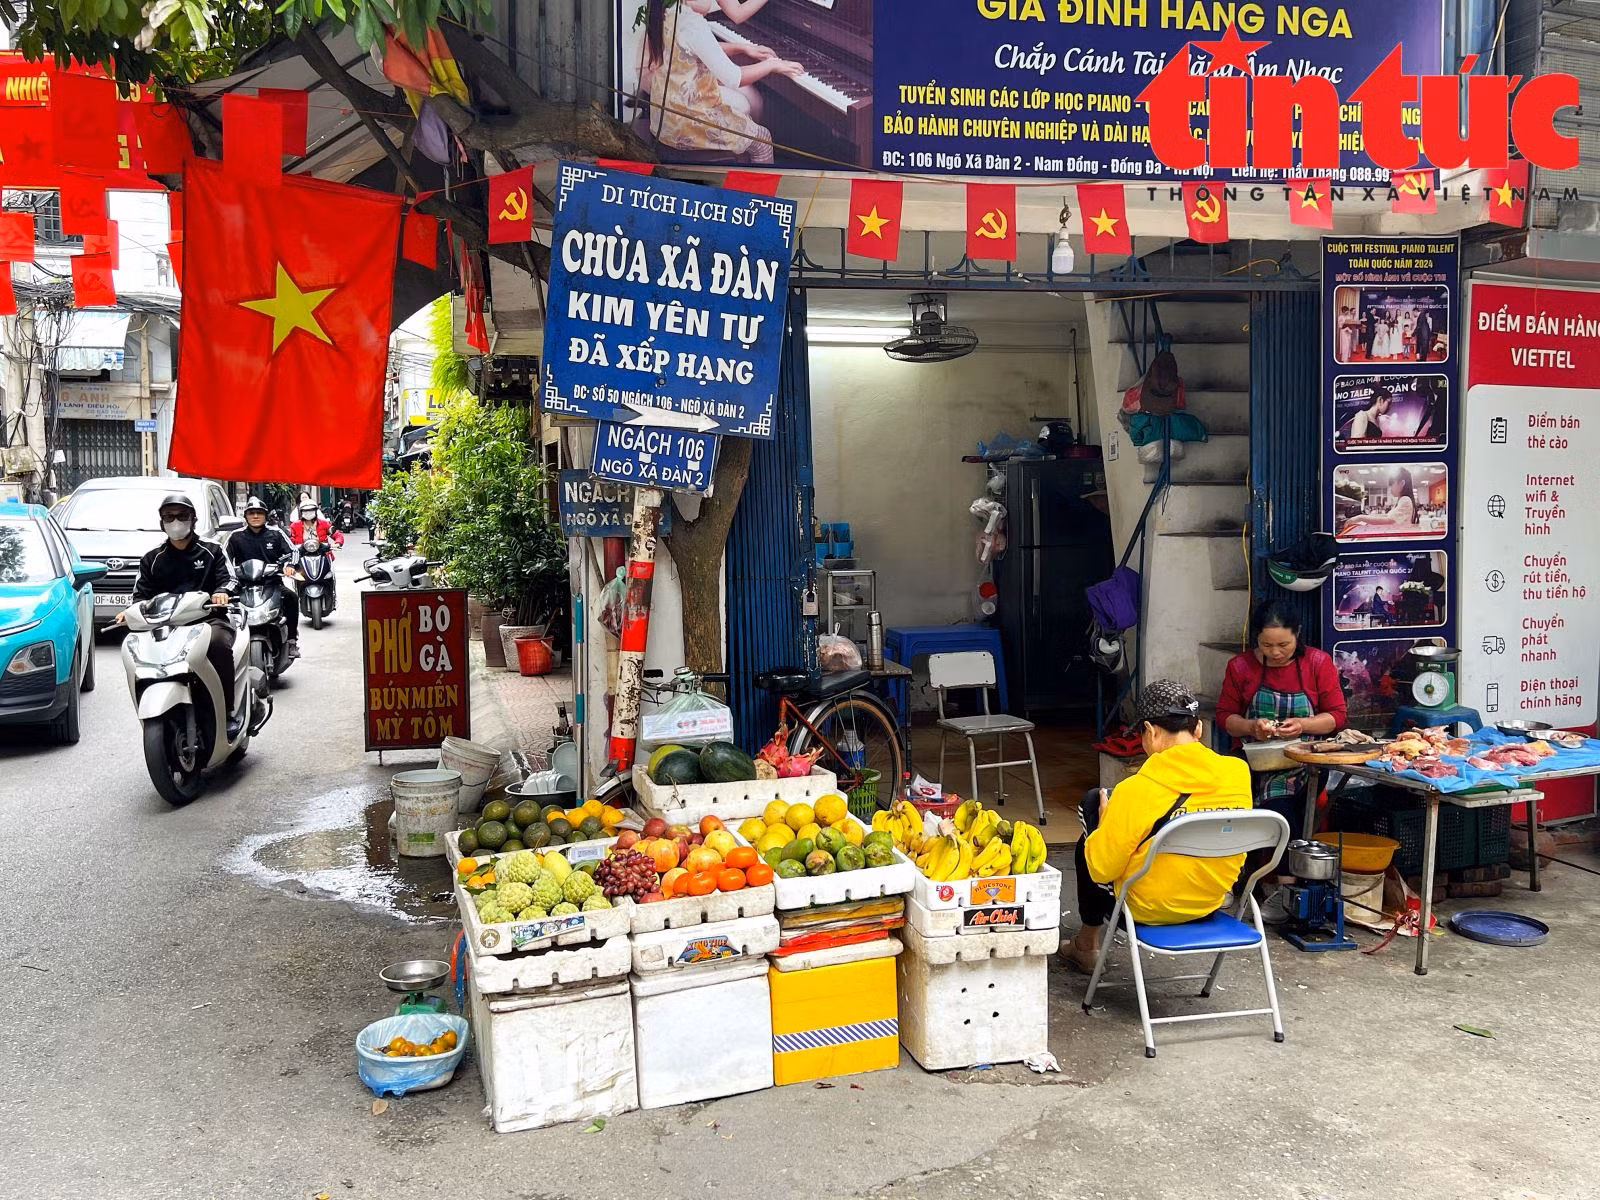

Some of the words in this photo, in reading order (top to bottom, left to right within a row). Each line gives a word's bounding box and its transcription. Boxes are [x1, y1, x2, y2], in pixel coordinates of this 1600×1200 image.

[977, 0, 1046, 22] GIA
[1276, 5, 1353, 39] NGA
[994, 41, 1057, 76] Chắp
[1063, 47, 1126, 73] Cánh
[1133, 51, 1167, 75] Tài
[5, 72, 50, 106] NHIỆ
[899, 79, 946, 105] TUYỂN
[950, 87, 986, 107] SINH
[989, 86, 1019, 108] CÁC
[1023, 87, 1051, 110] LỚP
[1054, 92, 1083, 114] HỌC
[1087, 94, 1131, 113] PIANO
[883, 109, 914, 134] BẢO
[918, 113, 959, 137] HÀNH
[963, 116, 1020, 139] CHUYÊN
[1024, 118, 1078, 144] NGHIỆP
[1081, 120, 1100, 142] VÀ
[1104, 121, 1128, 143] DÀI
[1132, 125, 1150, 147] HẠ
[882, 150, 905, 167] ĐC:
[908, 152, 932, 168] 106
[936, 153, 962, 170] Ngõ
[965, 154, 982, 169] Xã
[985, 154, 1010, 170] Đàn
[1013, 155, 1022, 171] 2
[1034, 156, 1063, 172] Nam
[1111, 156, 1142, 175] Đống
[1145, 159, 1162, 174] Đa
[601, 184, 625, 204] DI
[630, 186, 676, 214] TÍCH
[681, 199, 727, 223] LỊCH
[731, 202, 759, 227] SỬ
[1327, 242, 1349, 255] CUỘC
[1351, 243, 1363, 253] THI
[1364, 243, 1400, 254] FESTIVAL
[1401, 244, 1426, 254] PIANO
[1427, 243, 1455, 254] TALENT
[561, 224, 650, 285] CHÙA
[657, 235, 703, 292] XÃ
[710, 244, 779, 303] ĐÀN
[1348, 257, 1370, 269] TOÀN
[1371, 256, 1393, 269] QUỐC
[1414, 259, 1433, 269] 2024
[567, 290, 634, 327] KIM
[646, 300, 710, 337] YÊN
[720, 312, 765, 350] TỰ
[1478, 304, 1521, 333] ĐIỂM
[1525, 311, 1559, 336] BÁN
[568, 333, 610, 367] ĐÃ
[616, 336, 671, 374] XẾP
[675, 352, 755, 385] HẠNG
[1511, 347, 1576, 369] VIETTEL
[592, 383, 607, 402] SỐ
[607, 389, 619, 404] 50
[621, 388, 653, 407] NGÁCH
[656, 396, 673, 410] 106
[680, 398, 701, 415] NGÕ
[702, 399, 716, 416] XÃ
[717, 400, 738, 419] ĐÀN
[738, 405, 745, 420] 2
[1528, 411, 1557, 429] Điểm
[1560, 415, 1580, 429] bán
[607, 424, 672, 457] NGÁCH
[677, 436, 705, 461] 106
[1527, 435, 1546, 449] thẻ
[1549, 435, 1568, 449] cào
[600, 458, 634, 476] NGÕ
[638, 461, 659, 480] XÃ
[661, 465, 692, 485] ĐÀN
[695, 472, 704, 486] 2
[1525, 473, 1575, 486] Internet
[1525, 490, 1547, 502] wifi
[1550, 491, 1559, 502] &
[1524, 504, 1565, 522] Truyền
[1524, 522, 1550, 535] hình
[1523, 551, 1567, 569] Chuyển
[1523, 570, 1541, 584] rút
[1545, 567, 1570, 584] tiền,
[1523, 588, 1542, 600] thu
[1546, 584, 1569, 599] tiền
[1572, 586, 1586, 601] hộ
[1521, 613, 1565, 632] Chuyển
[368, 597, 413, 675] PHỞ
[418, 595, 451, 633] BÒ
[1521, 632, 1548, 649] phát
[419, 635, 452, 672] GÀ
[1521, 649, 1557, 663] nhanh
[370, 680, 410, 711] BÚN
[411, 674, 459, 710] MIẾN
[1520, 679, 1546, 693] Điện
[1550, 676, 1579, 691] thoại
[1520, 695, 1550, 710] chính
[1554, 693, 1582, 709] hãng
[376, 711, 404, 741] MỲ
[411, 710, 454, 740] TÔM
[969, 910, 990, 925] Air
